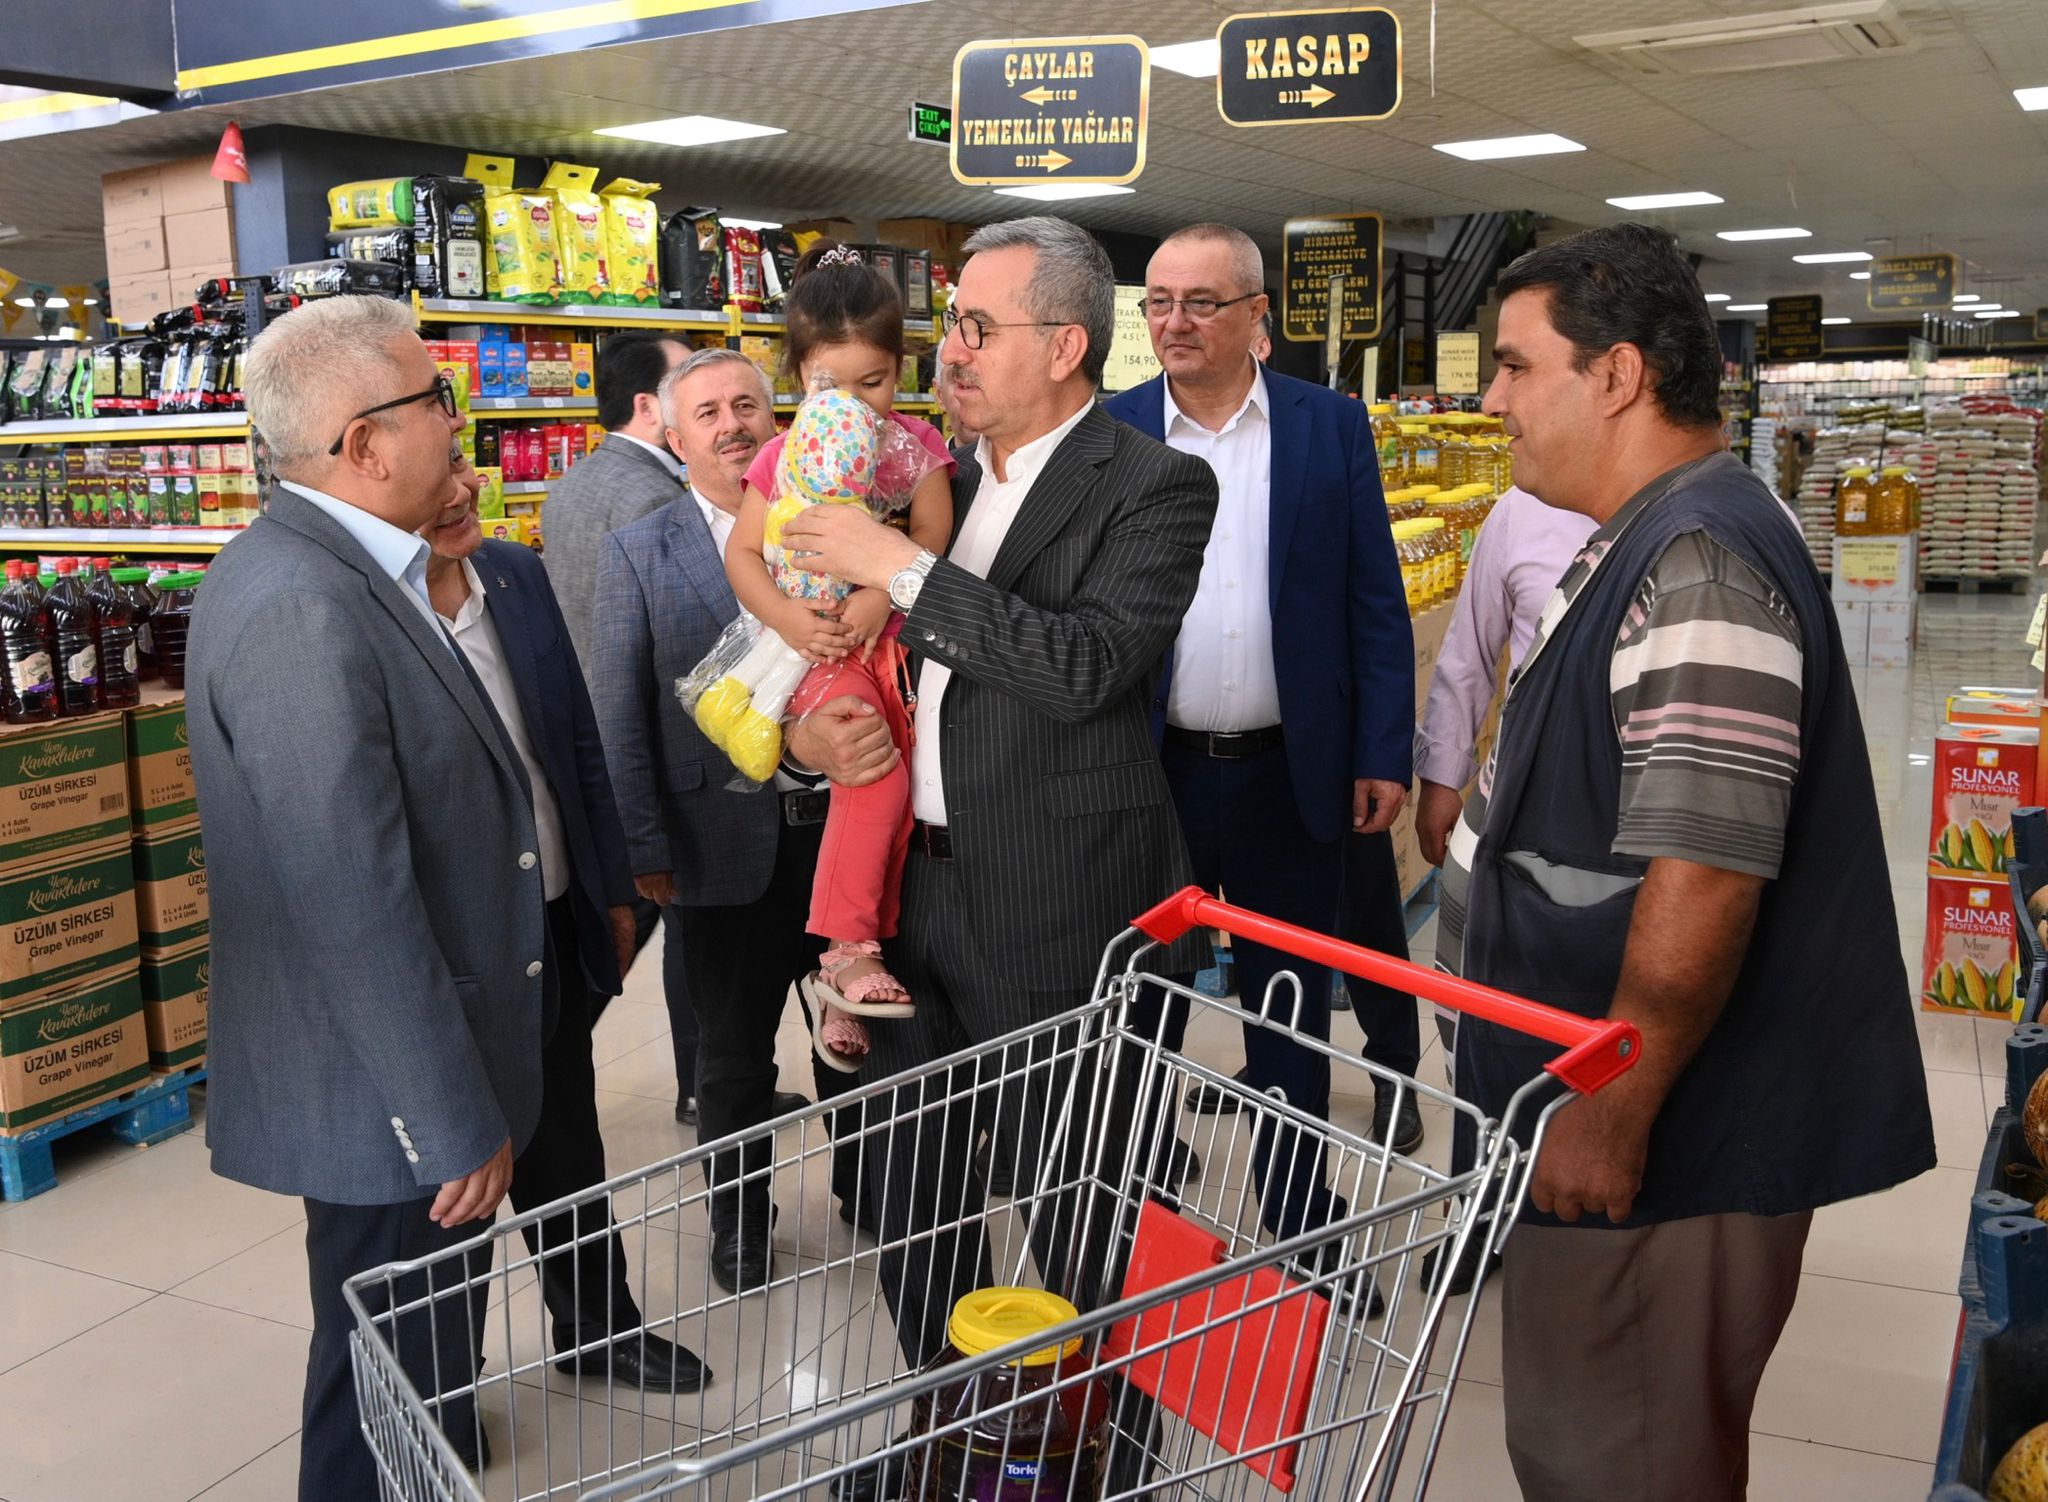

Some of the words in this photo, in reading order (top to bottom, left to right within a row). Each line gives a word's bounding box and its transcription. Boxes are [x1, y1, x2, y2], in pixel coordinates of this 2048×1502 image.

[1245, 33, 1369, 80] KASAP
[1005, 51, 1094, 87] ÇAYLAR
[919, 110, 939, 121] EXIT
[963, 112, 1056, 145] YEMEKLİK
[1062, 110, 1133, 145] YAĞLAR
[1304, 234, 1358, 247] HIRDAVAT
[1307, 262, 1353, 275] PLASTİK
[1291, 279, 1305, 290] EV
[1308, 274, 1369, 290] GERLERİ
[1298, 293, 1312, 304] EV
[1124, 355, 1156, 366] 154,90
[1951, 767, 2020, 787] SUNAR
[19, 783, 51, 800] ÜZÜM
[54, 774, 97, 793] SİRKESİ
[1951, 782, 2020, 794] PROFESYONEL
[30, 800, 56, 811] Grape
[58, 793, 89, 805] Vinegar
[1970, 797, 1999, 812] Mısır
[188, 871, 207, 887] ÜZÜ
[14, 921, 57, 945] ÜZÜM
[61, 902, 114, 933] SİRKESİ
[1944, 906, 2012, 927] SUNAR
[1943, 921, 2012, 935] PROFESYONEL
[29, 941, 62, 958] Grape
[65, 929, 104, 947] Vinegar
[1963, 937, 1991, 951] Mısır
[24, 1049, 67, 1074] ÜZÜM
[71, 1025, 123, 1059] SİRKESİ
[39, 1067, 72, 1085] Grape
[75, 1052, 114, 1073] Vinegar
